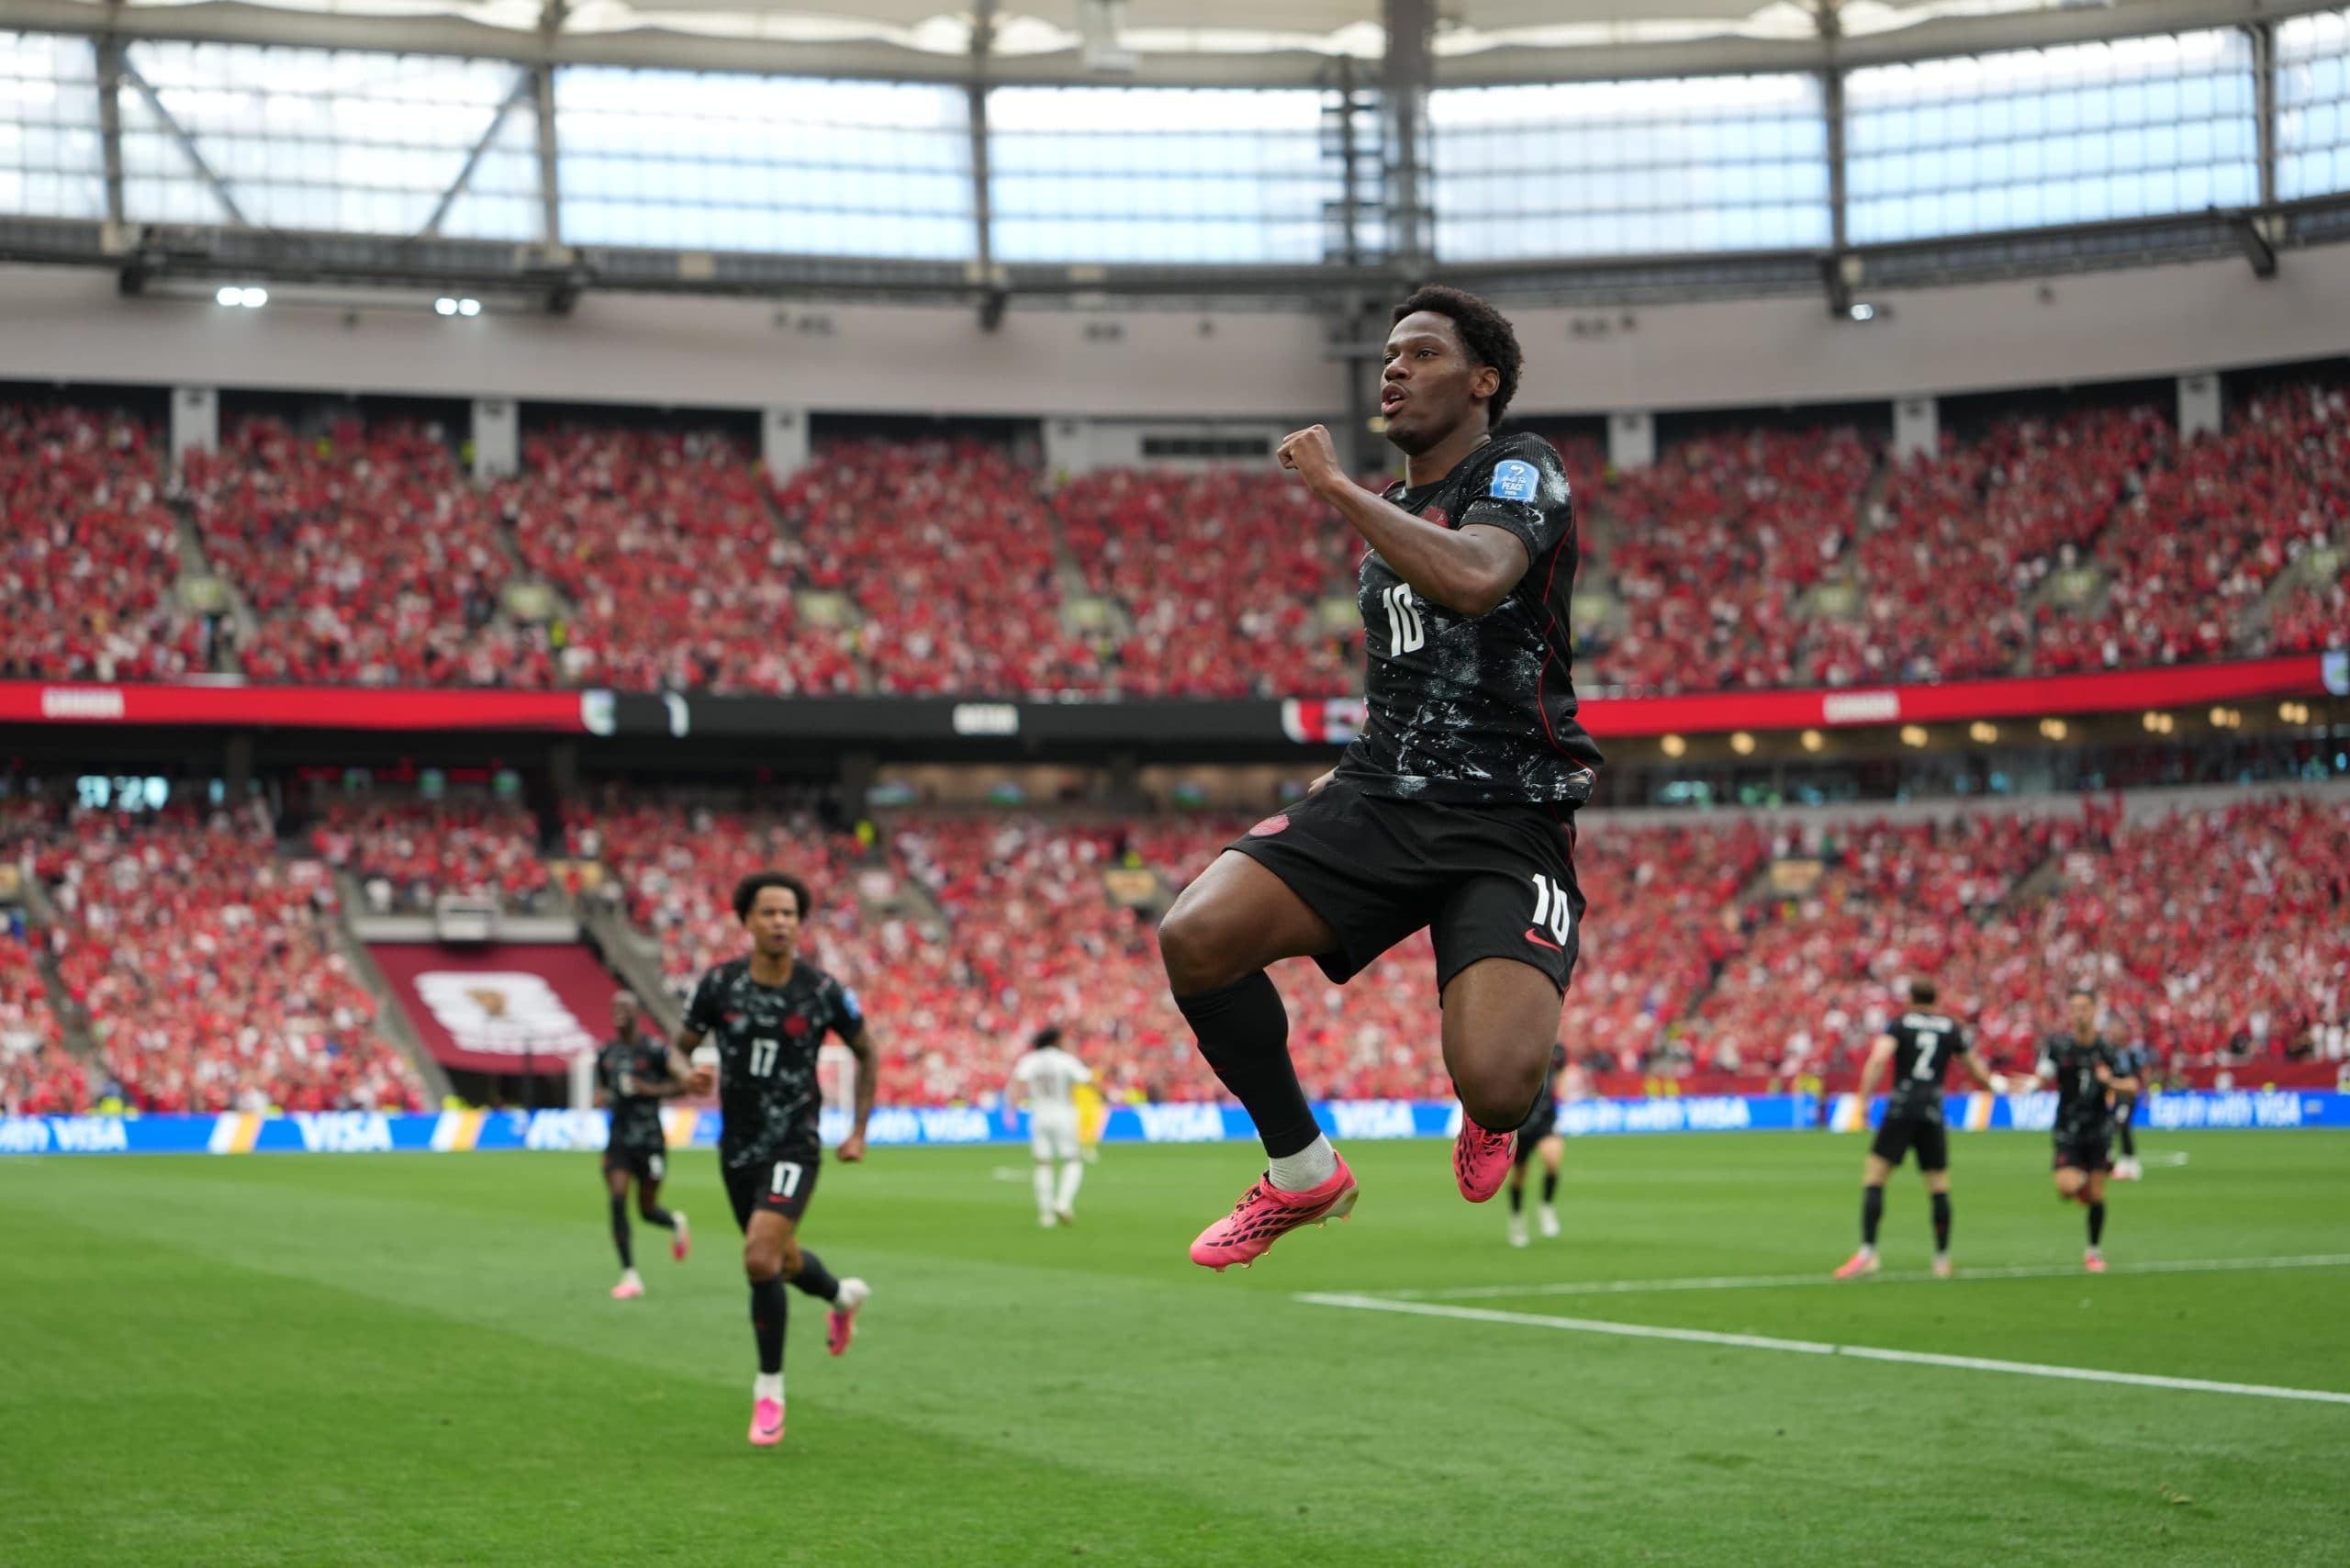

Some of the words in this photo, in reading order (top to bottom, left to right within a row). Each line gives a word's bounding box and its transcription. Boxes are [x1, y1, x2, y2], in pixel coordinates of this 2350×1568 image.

[1382, 582, 1424, 657] 10
[1531, 872, 1571, 946] 10
[749, 1037, 779, 1078] 17
[1911, 1030, 1939, 1081] 2
[50, 1114, 129, 1152] VISA
[771, 1160, 802, 1198] 17
